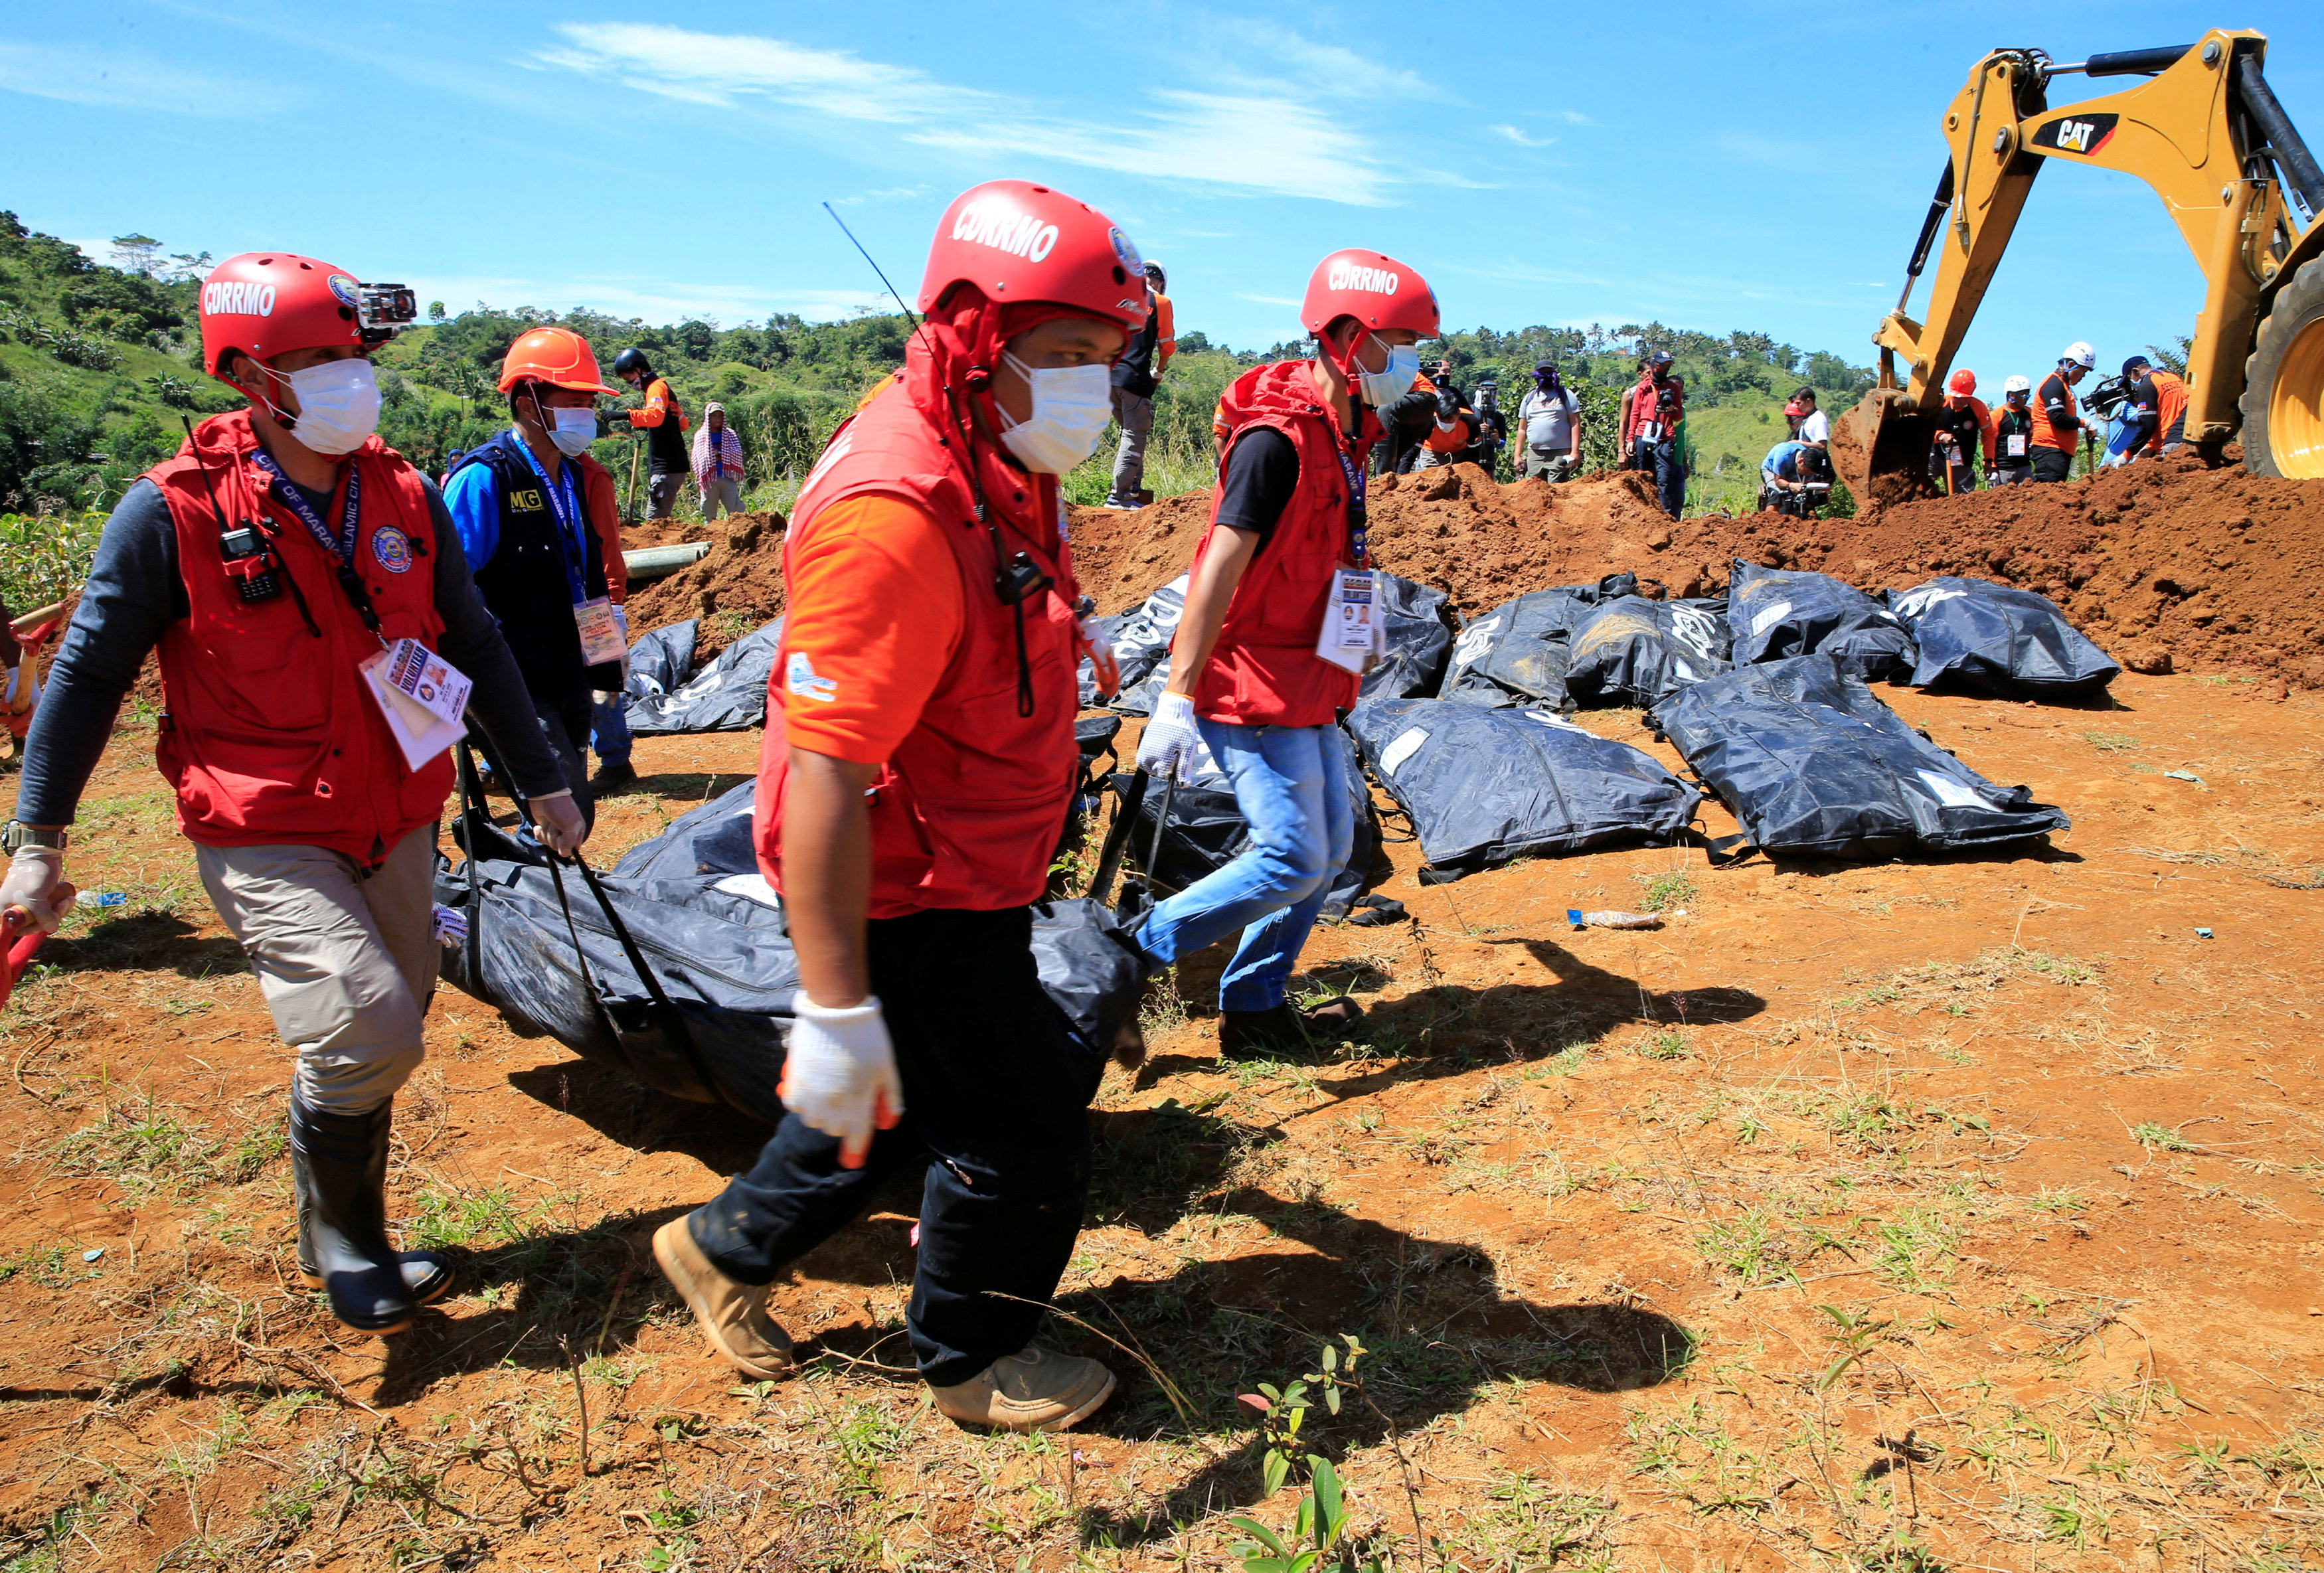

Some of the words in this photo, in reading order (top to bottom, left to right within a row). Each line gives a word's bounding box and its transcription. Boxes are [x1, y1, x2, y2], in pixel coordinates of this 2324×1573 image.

[2056, 120, 2095, 152] CAT
[952, 201, 1059, 263] CDRRMO
[1329, 265, 1398, 295] CDRRMO
[204, 281, 276, 317] CDRRMO
[257, 454, 287, 481] CITY
[282, 485, 302, 503] OF
[349, 469, 360, 499] CITY
[510, 489, 543, 509] MG
[400, 645, 426, 691] VOLUNTEER
